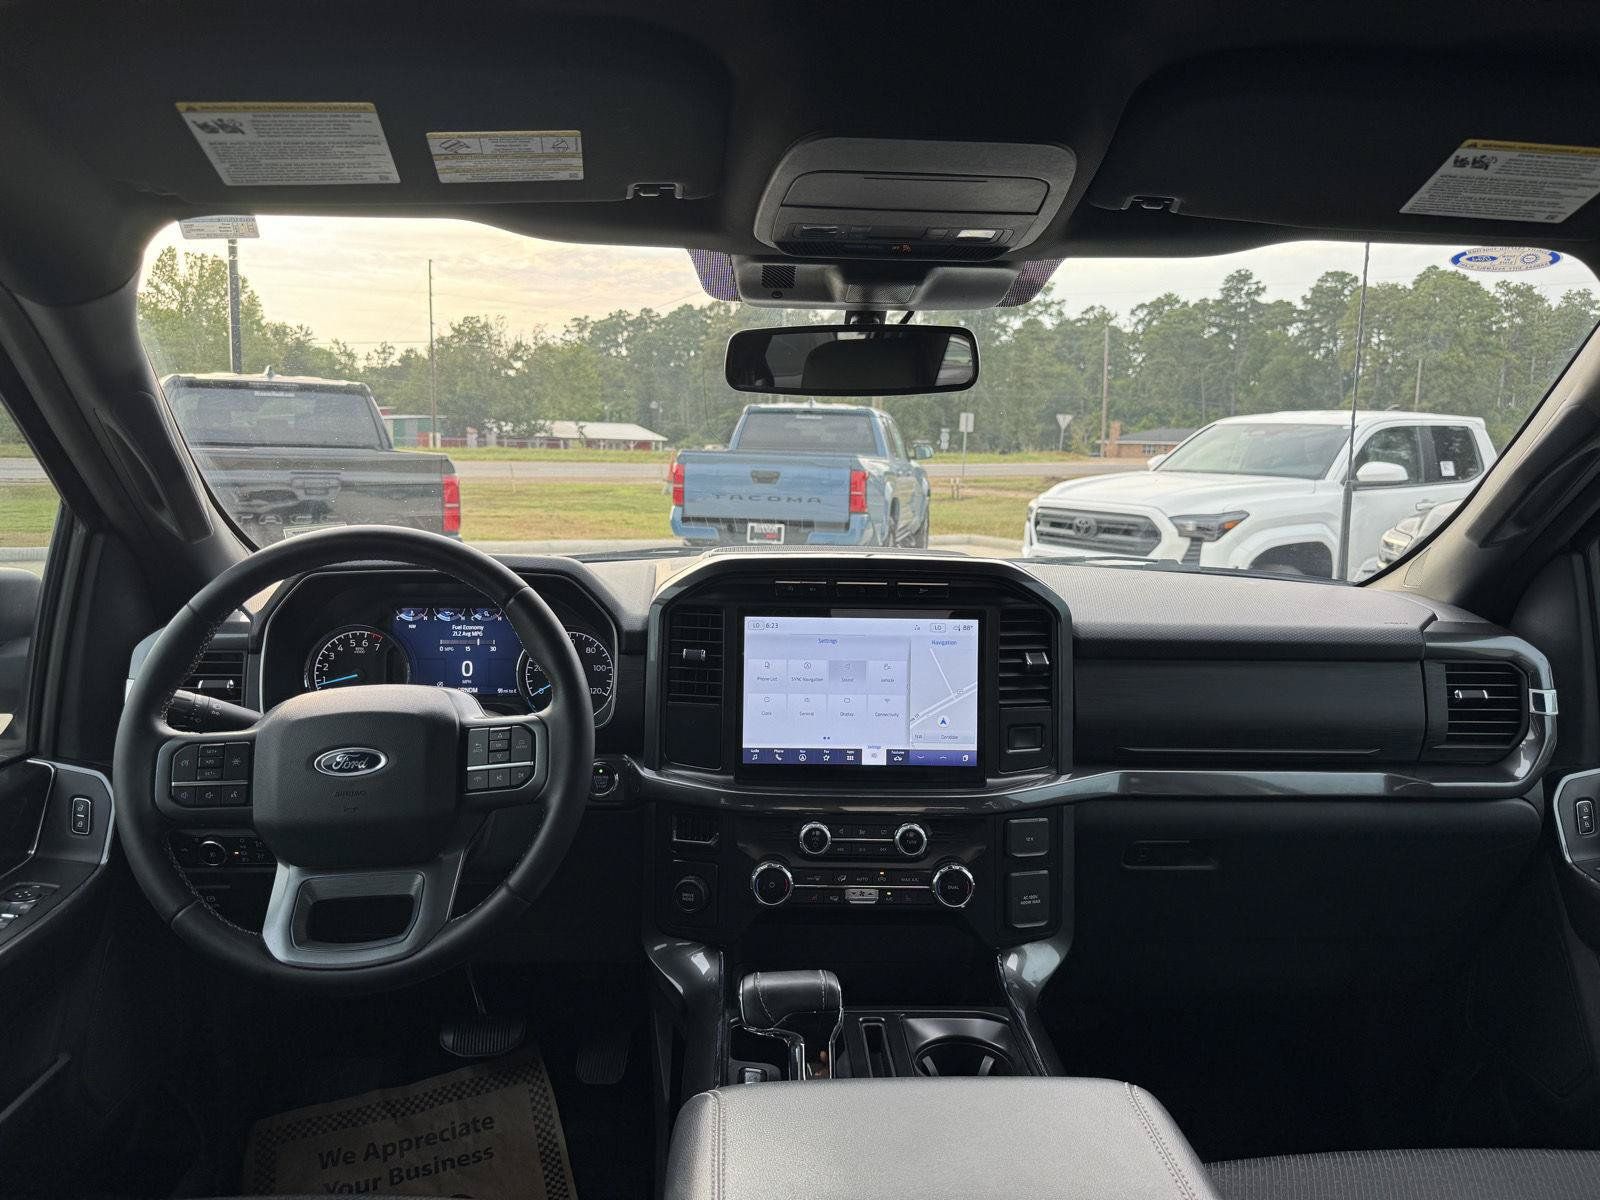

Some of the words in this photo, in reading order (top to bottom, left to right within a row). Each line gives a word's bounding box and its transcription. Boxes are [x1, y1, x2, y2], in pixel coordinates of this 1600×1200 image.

[715, 493, 822, 504] TACOMA
[451, 624, 462, 632] Fuel
[462, 624, 485, 634] Economy
[350, 639, 356, 647] 5
[362, 639, 369, 647] 6
[817, 637, 839, 646] Settings
[931, 639, 958, 647] Navigation
[373, 643, 381, 651] 7
[328, 652, 335, 660] 3
[322, 663, 329, 671] 2
[461, 660, 474, 677] 0
[593, 664, 607, 672] 100
[590, 687, 603, 695] 120
[331, 753, 369, 770] Ford
[317, 1146, 356, 1171] We
[363, 1115, 495, 1163] Appreciate
[324, 1176, 382, 1195] Your
[389, 1147, 494, 1187] Business
